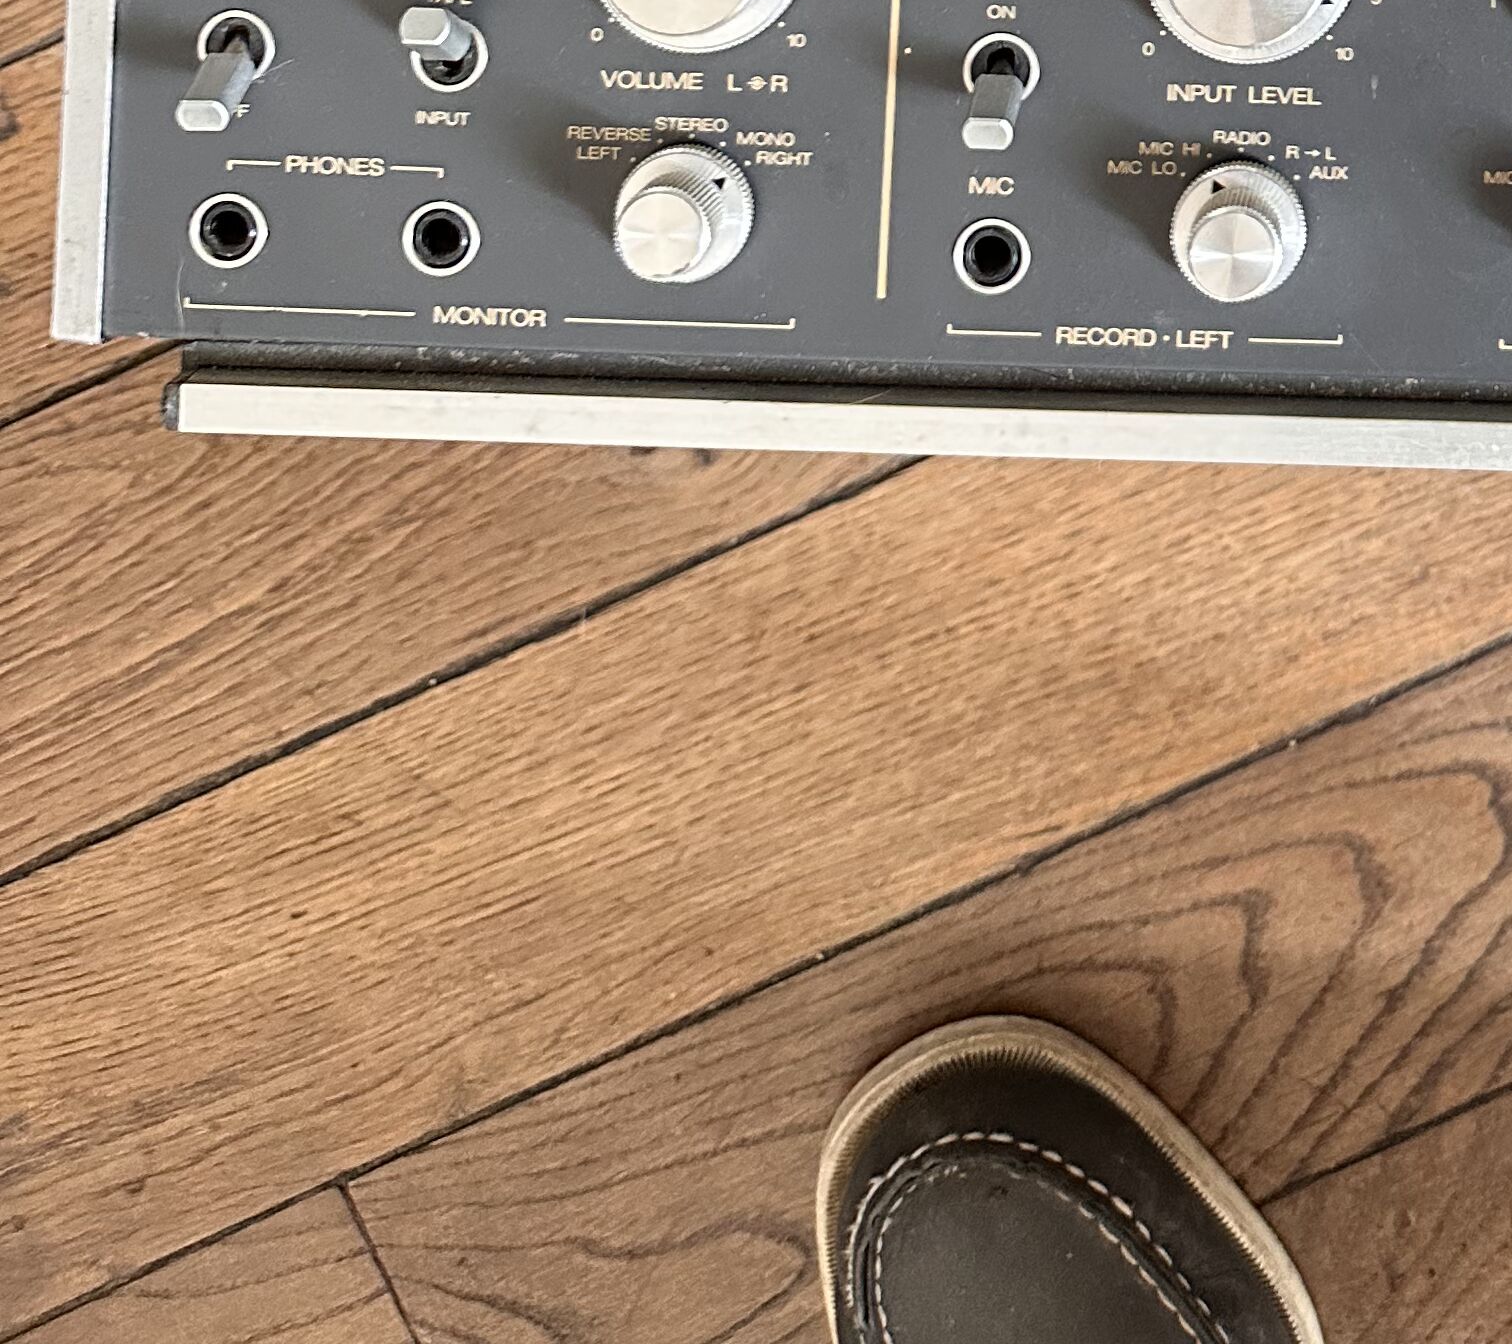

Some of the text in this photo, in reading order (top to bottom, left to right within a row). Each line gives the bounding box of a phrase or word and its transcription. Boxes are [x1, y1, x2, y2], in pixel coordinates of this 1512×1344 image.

[986, 4, 1017, 20] ON
[590, 27, 604, 42] 0
[786, 33, 807, 48] 10
[1141, 41, 1156, 56] 0
[1335, 47, 1355, 61] 10
[599, 69, 705, 91] VOLUME
[1166, 83, 1323, 106] INPUT LEVEL
[414, 110, 472, 126] INPUT
[654, 116, 730, 133] STEREO
[566, 125, 652, 142] REVERSE
[736, 131, 796, 147] MONO
[1212, 129, 1272, 146] RADIO
[576, 145, 622, 160] LEFT
[1138, 141, 1201, 156] MIC HI
[284, 154, 385, 177] PHONES
[755, 150, 814, 166] RIGHT
[1107, 159, 1177, 176] MIC LO
[1308, 165, 1349, 180] AUX
[968, 176, 1015, 196] MIC
[432, 305, 547, 328] MONITOR
[1055, 326, 1235, 350] RECORD LEFT
